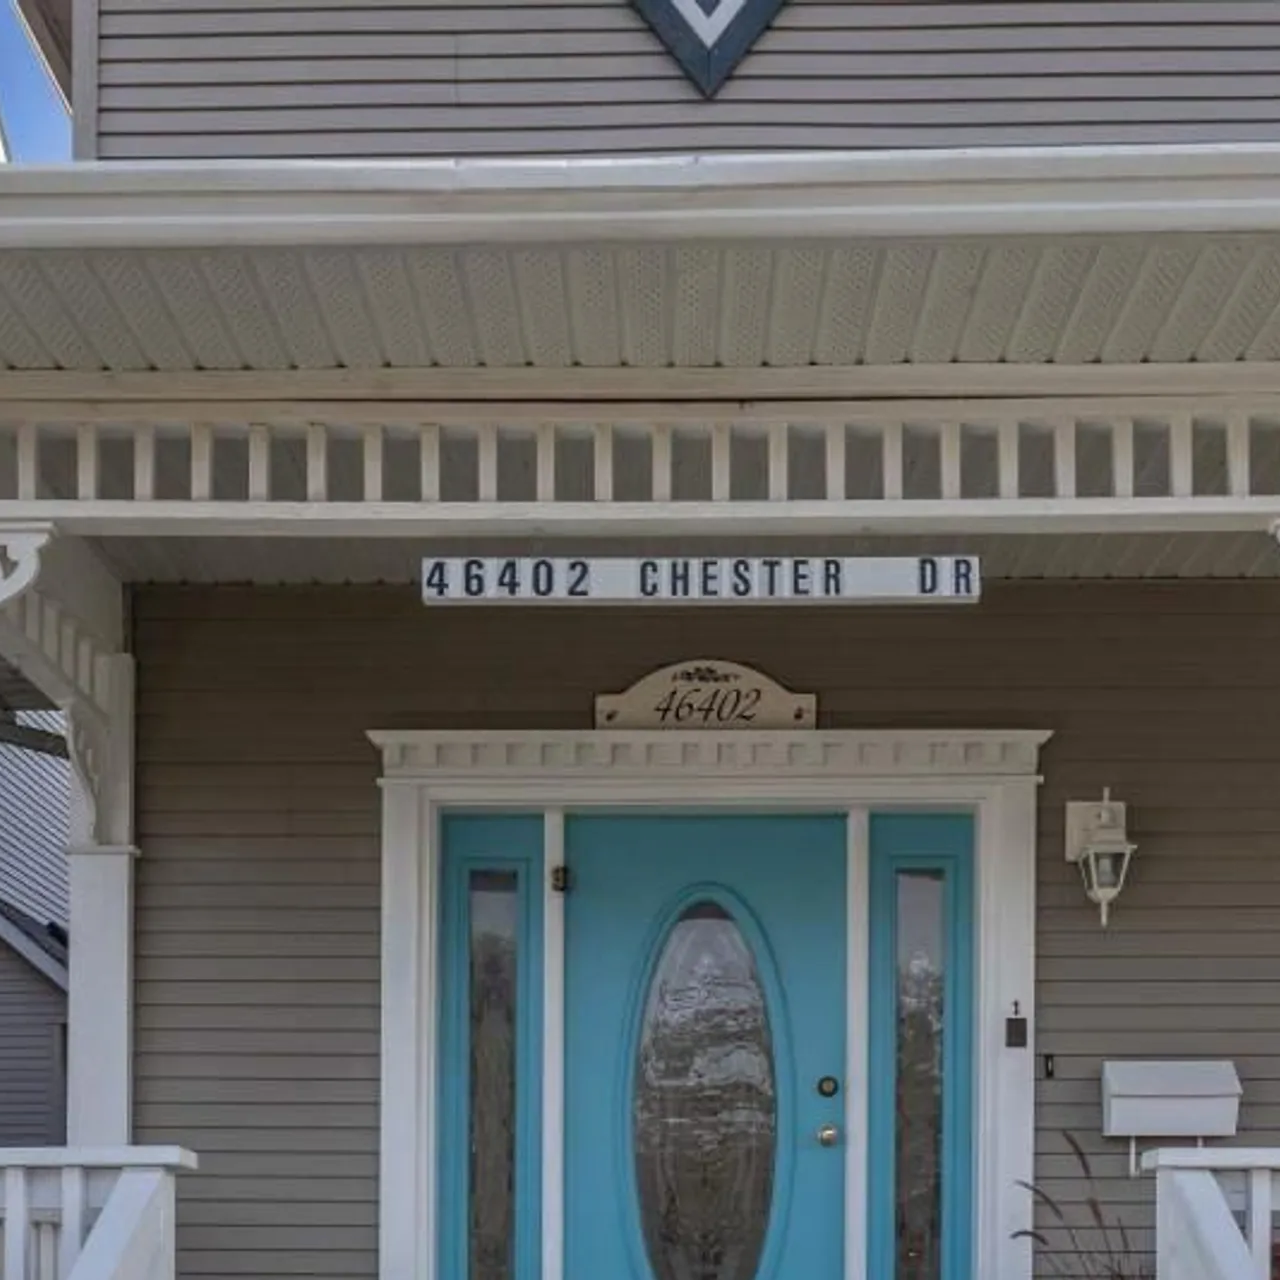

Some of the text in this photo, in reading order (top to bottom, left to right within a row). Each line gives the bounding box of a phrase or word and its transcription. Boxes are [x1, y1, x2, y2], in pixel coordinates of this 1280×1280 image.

[426, 559, 972, 597] 46402 CHESTER DR
[653, 688, 762, 723] 46402
